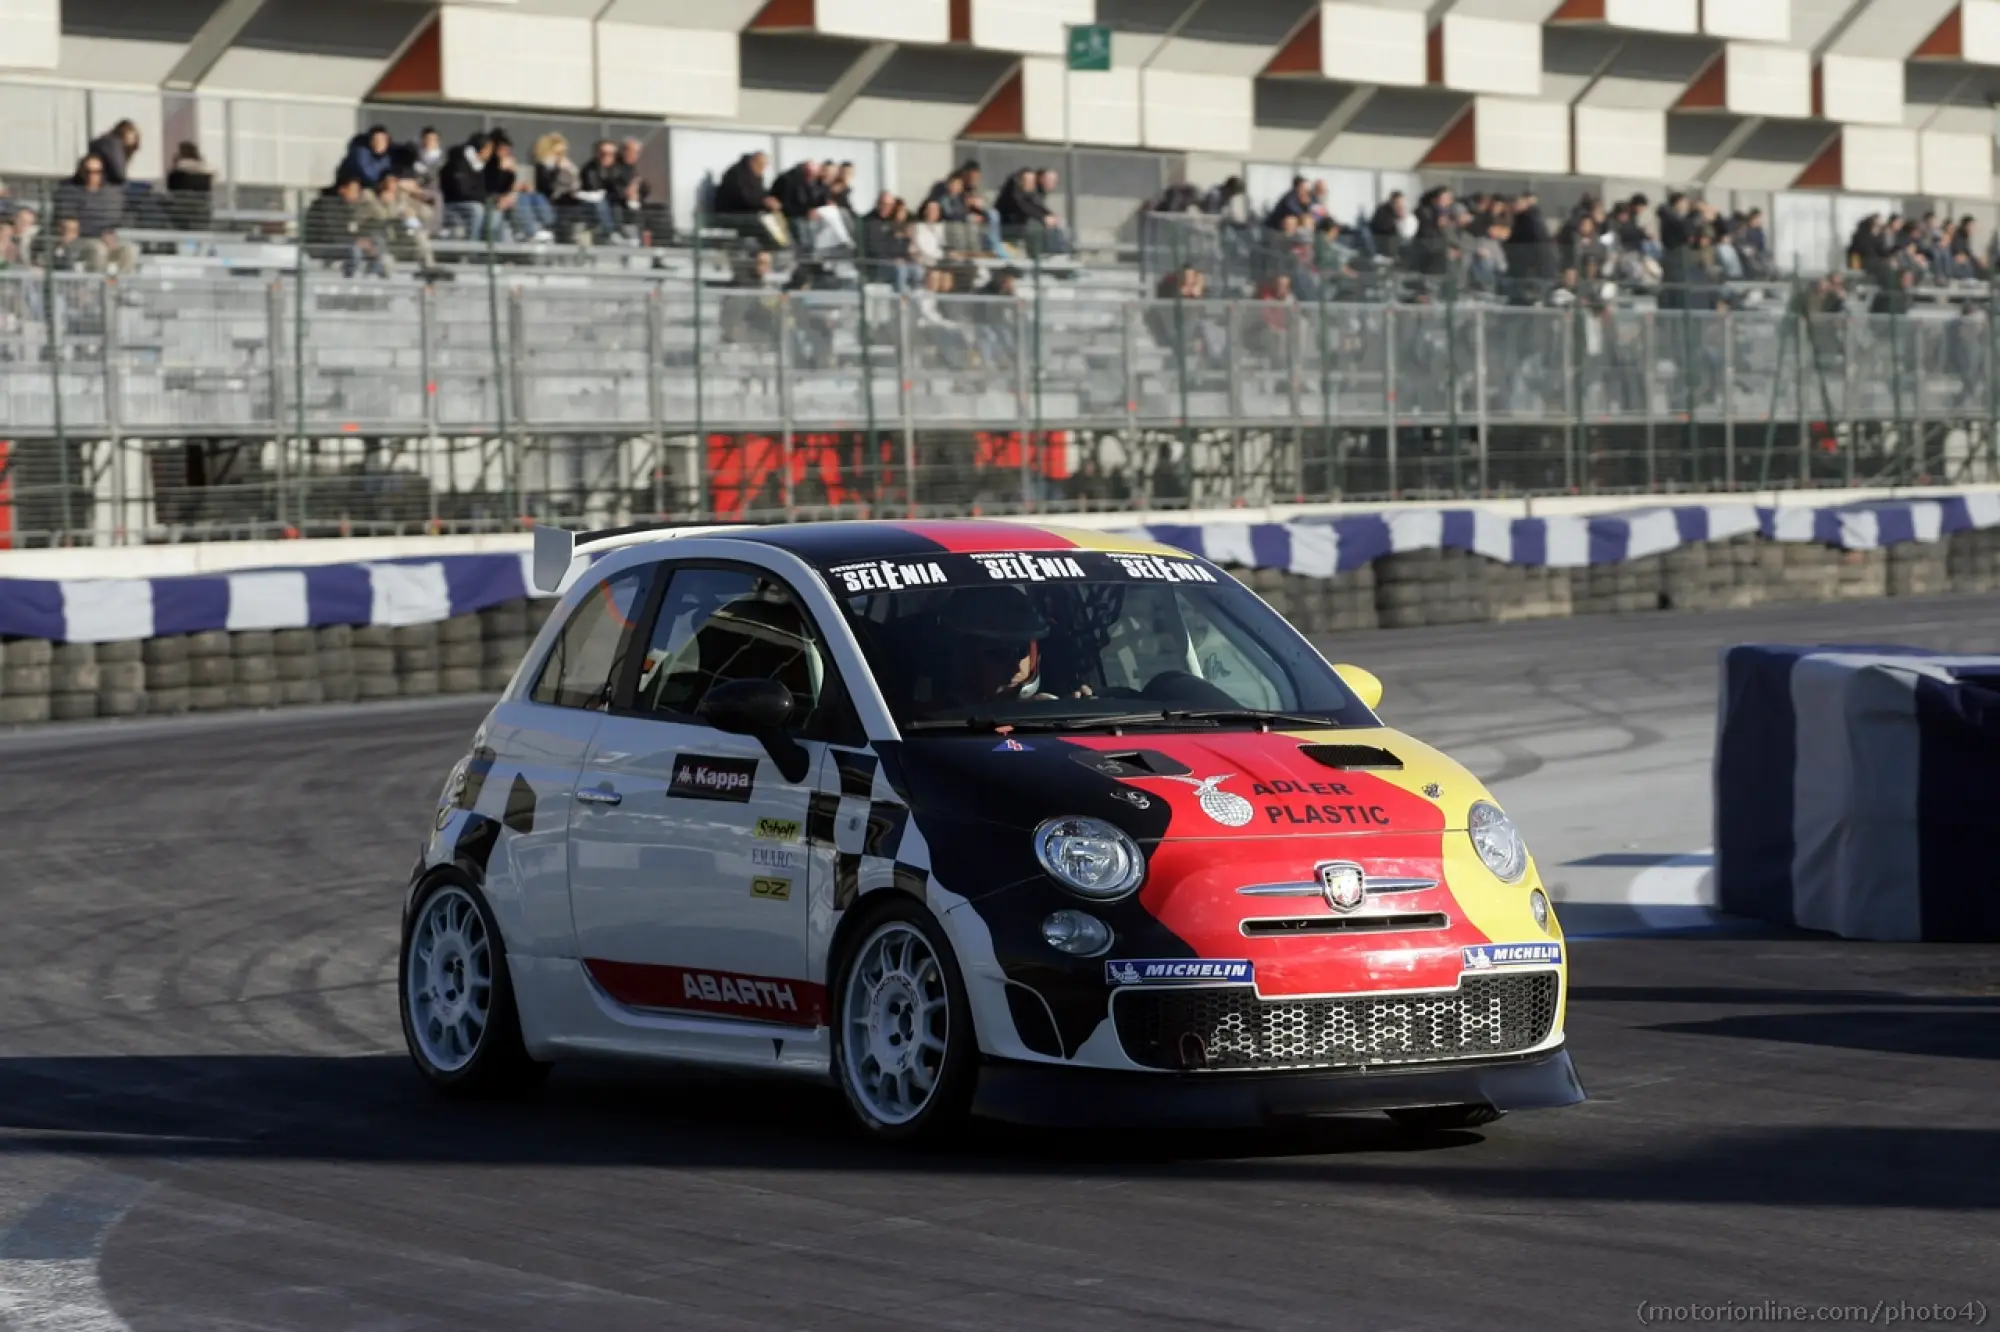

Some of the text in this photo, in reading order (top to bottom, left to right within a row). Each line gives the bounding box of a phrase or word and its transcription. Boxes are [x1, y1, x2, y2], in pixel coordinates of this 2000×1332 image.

[843, 560, 948, 592] SELENIA
[983, 553, 1086, 581] SELENIA
[1120, 556, 1218, 583] SELENIA
[696, 766, 749, 790] Kappa
[1253, 778, 1353, 798] ADLER
[1265, 805, 1391, 825] PLASTIC
[1494, 946, 1559, 960] MICHELIN
[1145, 964, 1247, 977] MICHELIN
[682, 973, 798, 1011] ABARTH
